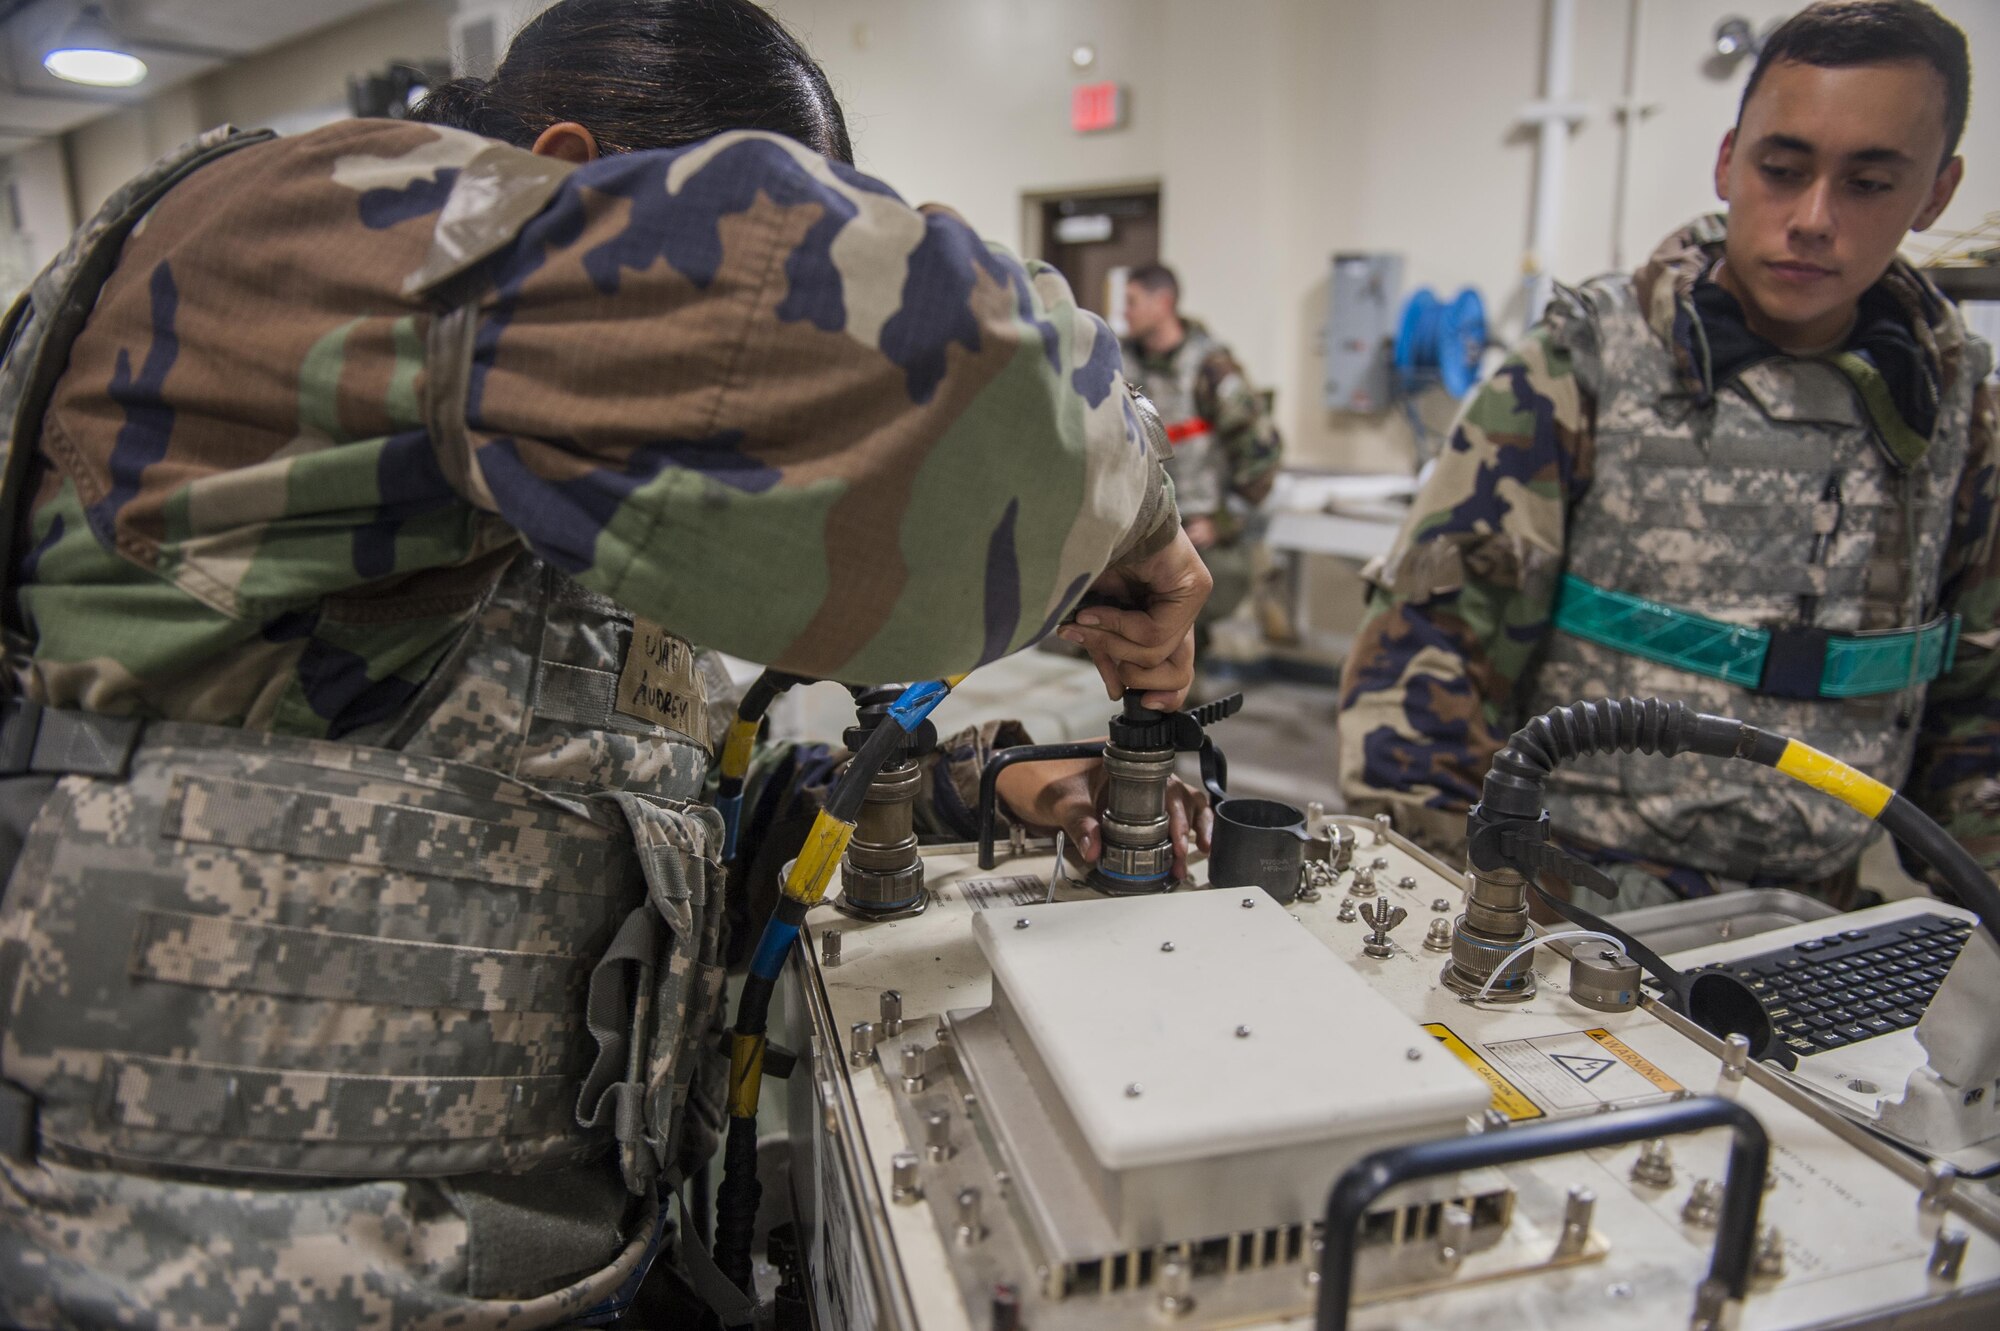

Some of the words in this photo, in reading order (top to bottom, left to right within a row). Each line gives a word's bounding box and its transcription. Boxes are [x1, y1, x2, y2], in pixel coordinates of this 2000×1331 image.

[632, 677, 689, 728] AUDREY
[1477, 1067, 1513, 1096] CAUTION
[1604, 1039, 1669, 1083] WARNING
